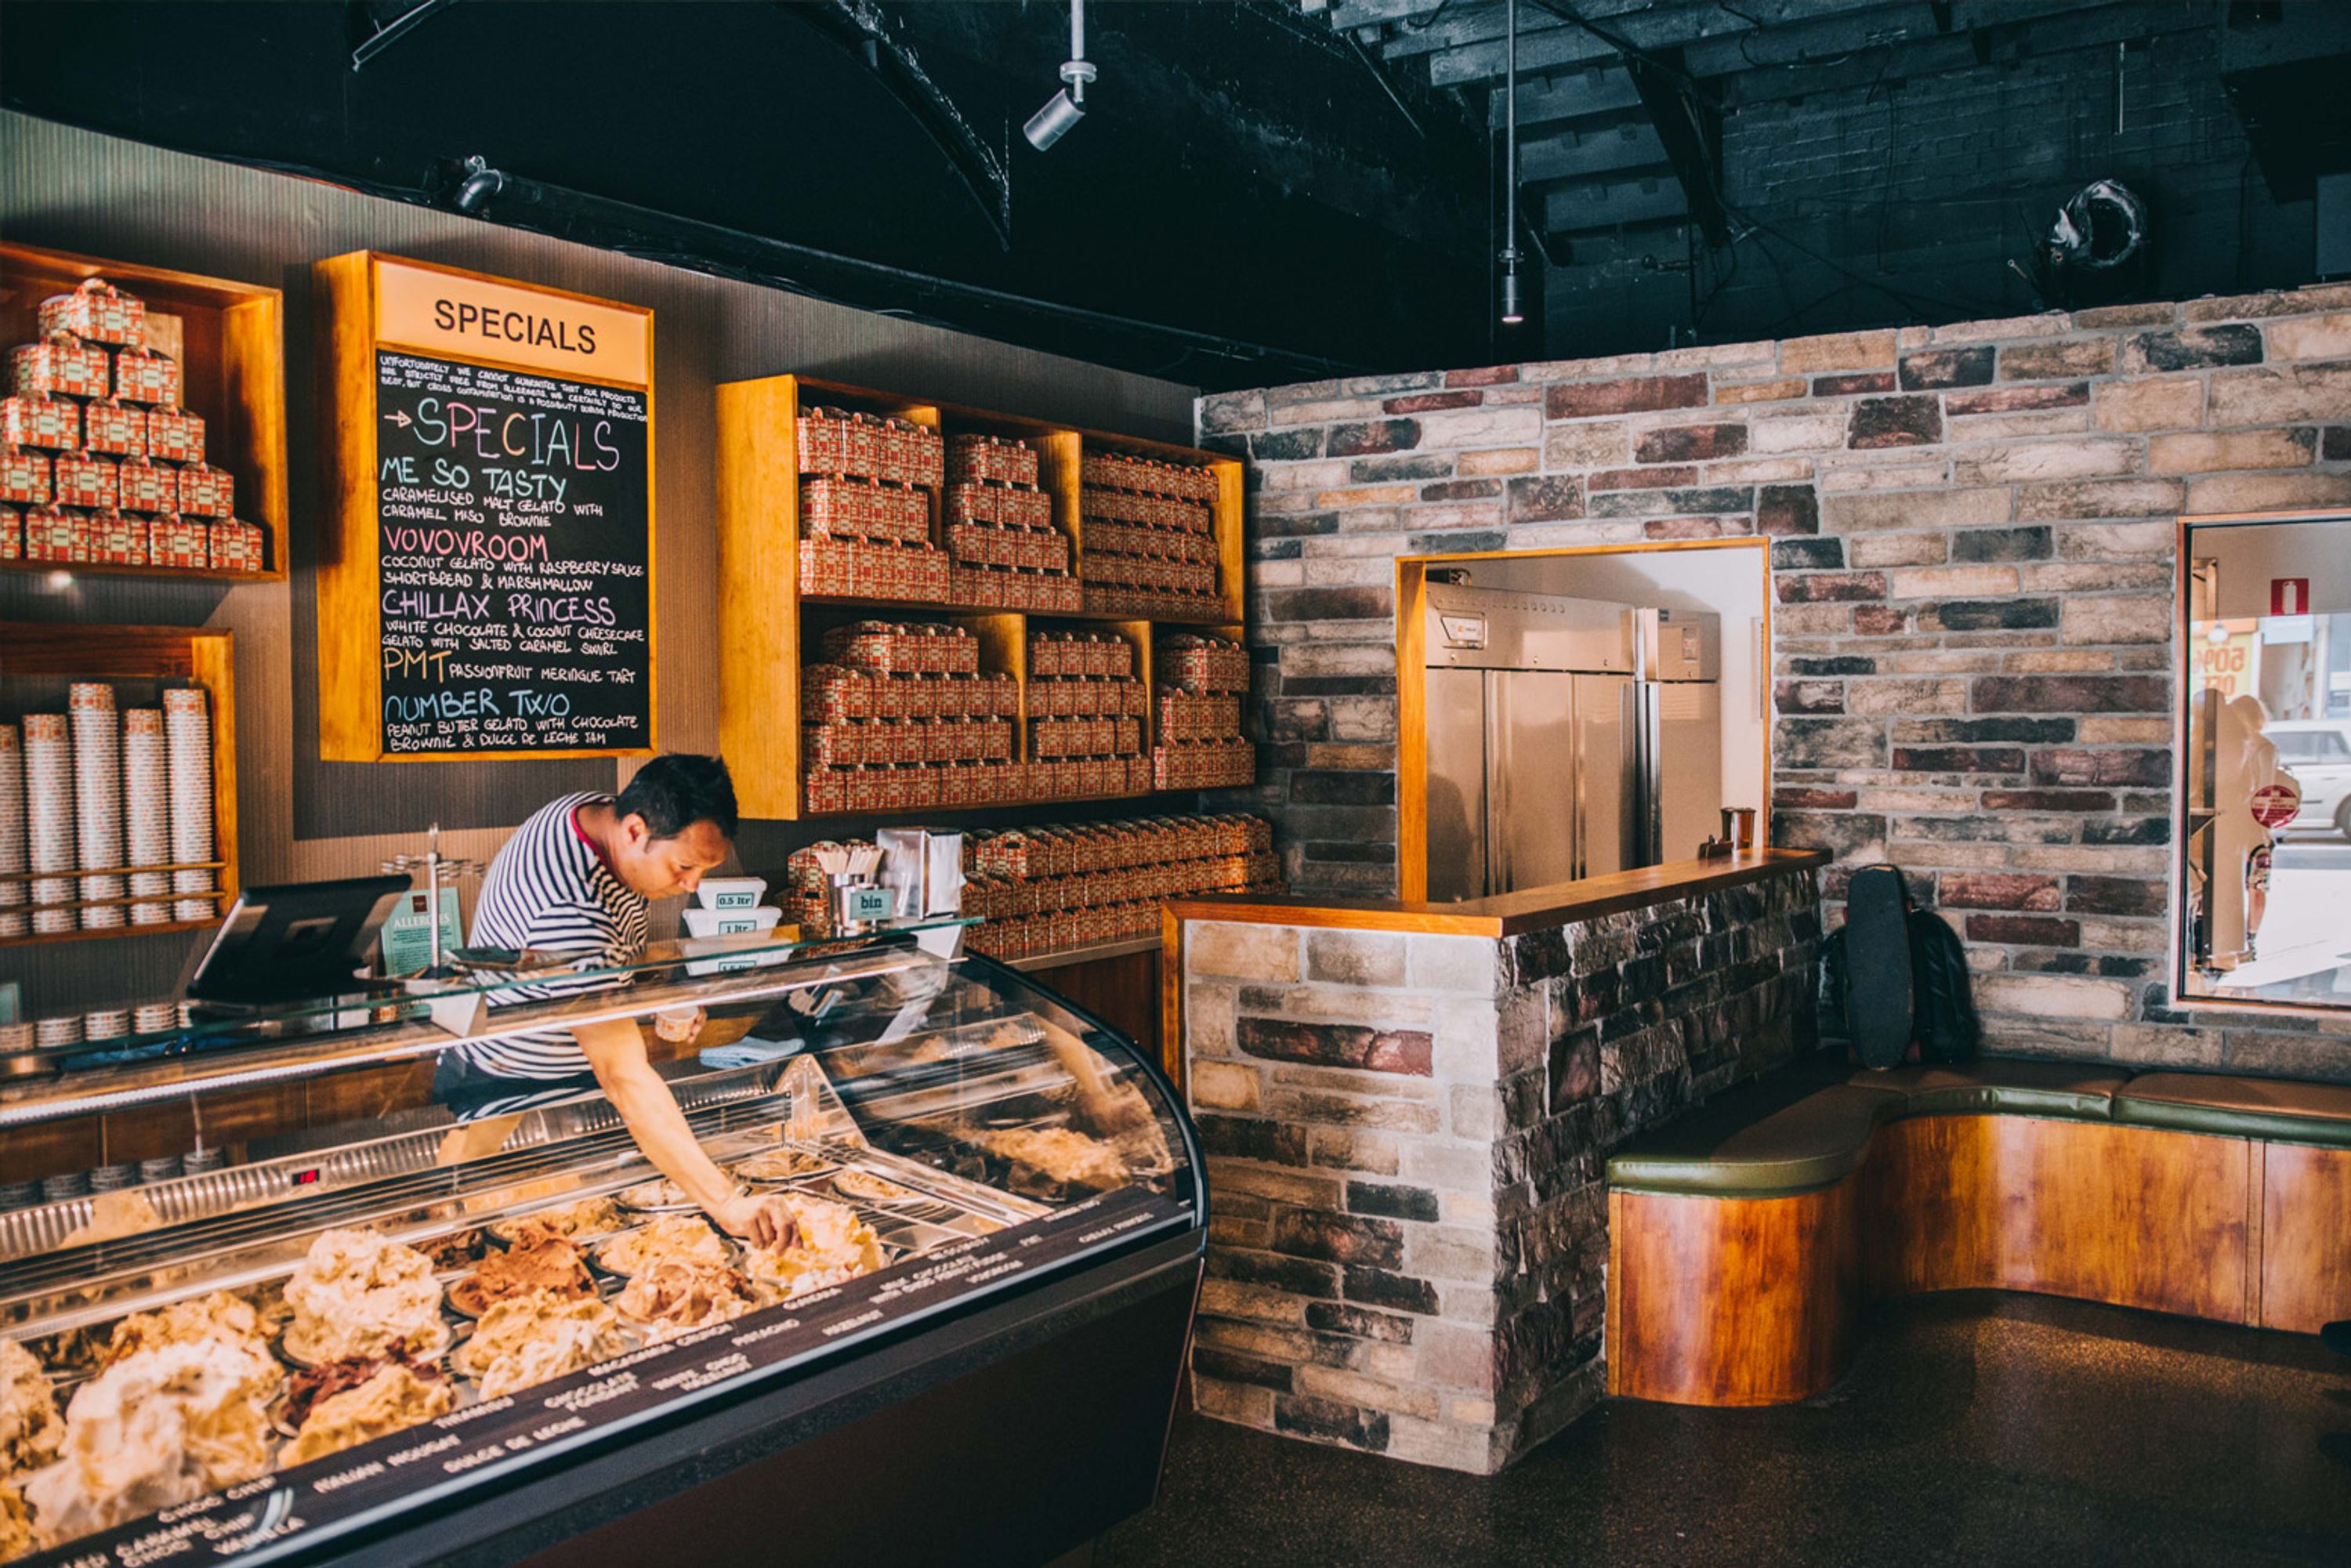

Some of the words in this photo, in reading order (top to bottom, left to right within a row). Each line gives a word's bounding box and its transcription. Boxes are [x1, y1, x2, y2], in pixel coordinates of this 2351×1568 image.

[434, 299, 596, 354] SPECIALS
[379, 356, 450, 374] UNFORTUNATELY
[456, 368, 471, 376] WE
[478, 371, 509, 382] CANNOT
[514, 376, 556, 391] GUARANTEE
[560, 383, 580, 393] THAT
[583, 389, 598, 397] OUR
[600, 390, 636, 404] PRODUCTS
[381, 367, 397, 376] ARE
[404, 370, 443, 382] STRICTLY
[449, 375, 470, 386] FREE
[476, 380, 498, 390] FROM
[550, 392, 563, 400] WE
[568, 394, 607, 407] CERTAINLY
[628, 404, 643, 414] OUR
[407, 379, 422, 388] BUT
[427, 382, 452, 393] CROSS
[456, 386, 513, 402] CONTAMINATION
[517, 395, 525, 404] IS
[536, 398, 577, 412] POSSIBILITY
[607, 409, 647, 422] PRODUCTION
[413, 397, 620, 471] SPECIALS
[382, 456, 419, 483] ME
[432, 458, 469, 490] SO
[482, 468, 567, 503] TASTY
[382, 488, 474, 505] CARAMELISED
[484, 497, 513, 512] MALT
[517, 499, 565, 514] GELATO
[573, 504, 603, 516] WITH
[382, 505, 447, 521] CARAMEL
[455, 509, 485, 524] MISO
[498, 513, 552, 527] BROWNIE
[383, 525, 549, 562] VOVOVROOM
[382, 555, 444, 569] COCONUT
[450, 557, 494, 571] GELATO
[504, 559, 533, 574] WITH
[539, 559, 610, 575] RASPBERRY
[611, 562, 644, 577] SAUCE
[383, 571, 473, 588] SHORTBREAD
[481, 574, 493, 588] &
[498, 575, 593, 592] MARSHMALLOW
[382, 589, 491, 621] CHILLAX
[508, 592, 616, 626] PRINCESS
[382, 635, 423, 648] GELATO
[431, 638, 459, 650] WITH
[469, 639, 512, 652] SALTED
[519, 639, 572, 654] CARAMEL
[581, 643, 618, 655] SWIRL
[386, 620, 429, 634] WHITE
[434, 622, 509, 637] CHOCOLATE
[513, 623, 524, 638] &
[527, 625, 572, 638] COCONUT
[577, 627, 644, 642] CHEESECAKE
[383, 647, 452, 683] PMT
[449, 664, 533, 680] PASSIONFRUIT
[541, 667, 603, 683] MERINGUE
[607, 669, 636, 683] TART
[386, 687, 500, 722] NUMBER
[509, 690, 570, 716] TWO
[386, 724, 431, 737] PEANUT
[437, 718, 479, 734] BUTTER
[484, 717, 527, 731] GELATO
[535, 717, 565, 730] WITH
[571, 715, 639, 729] CHOCOLATE
[390, 735, 456, 752] BROWNIE
[462, 734, 475, 748] &
[479, 733, 515, 746] DULCE
[543, 733, 579, 744] LECHE
[860, 895, 882, 909] bin
[394, 913, 451, 929] ALLERGES
[313, 1461, 386, 1494] ITALIAN
[158, 1495, 225, 1523] CHOC
[226, 1475, 277, 1500] CHIP
[115, 1515, 217, 1558] CARAMEL
[123, 1538, 194, 1567] CHOC
[204, 1512, 255, 1540] CHIP
